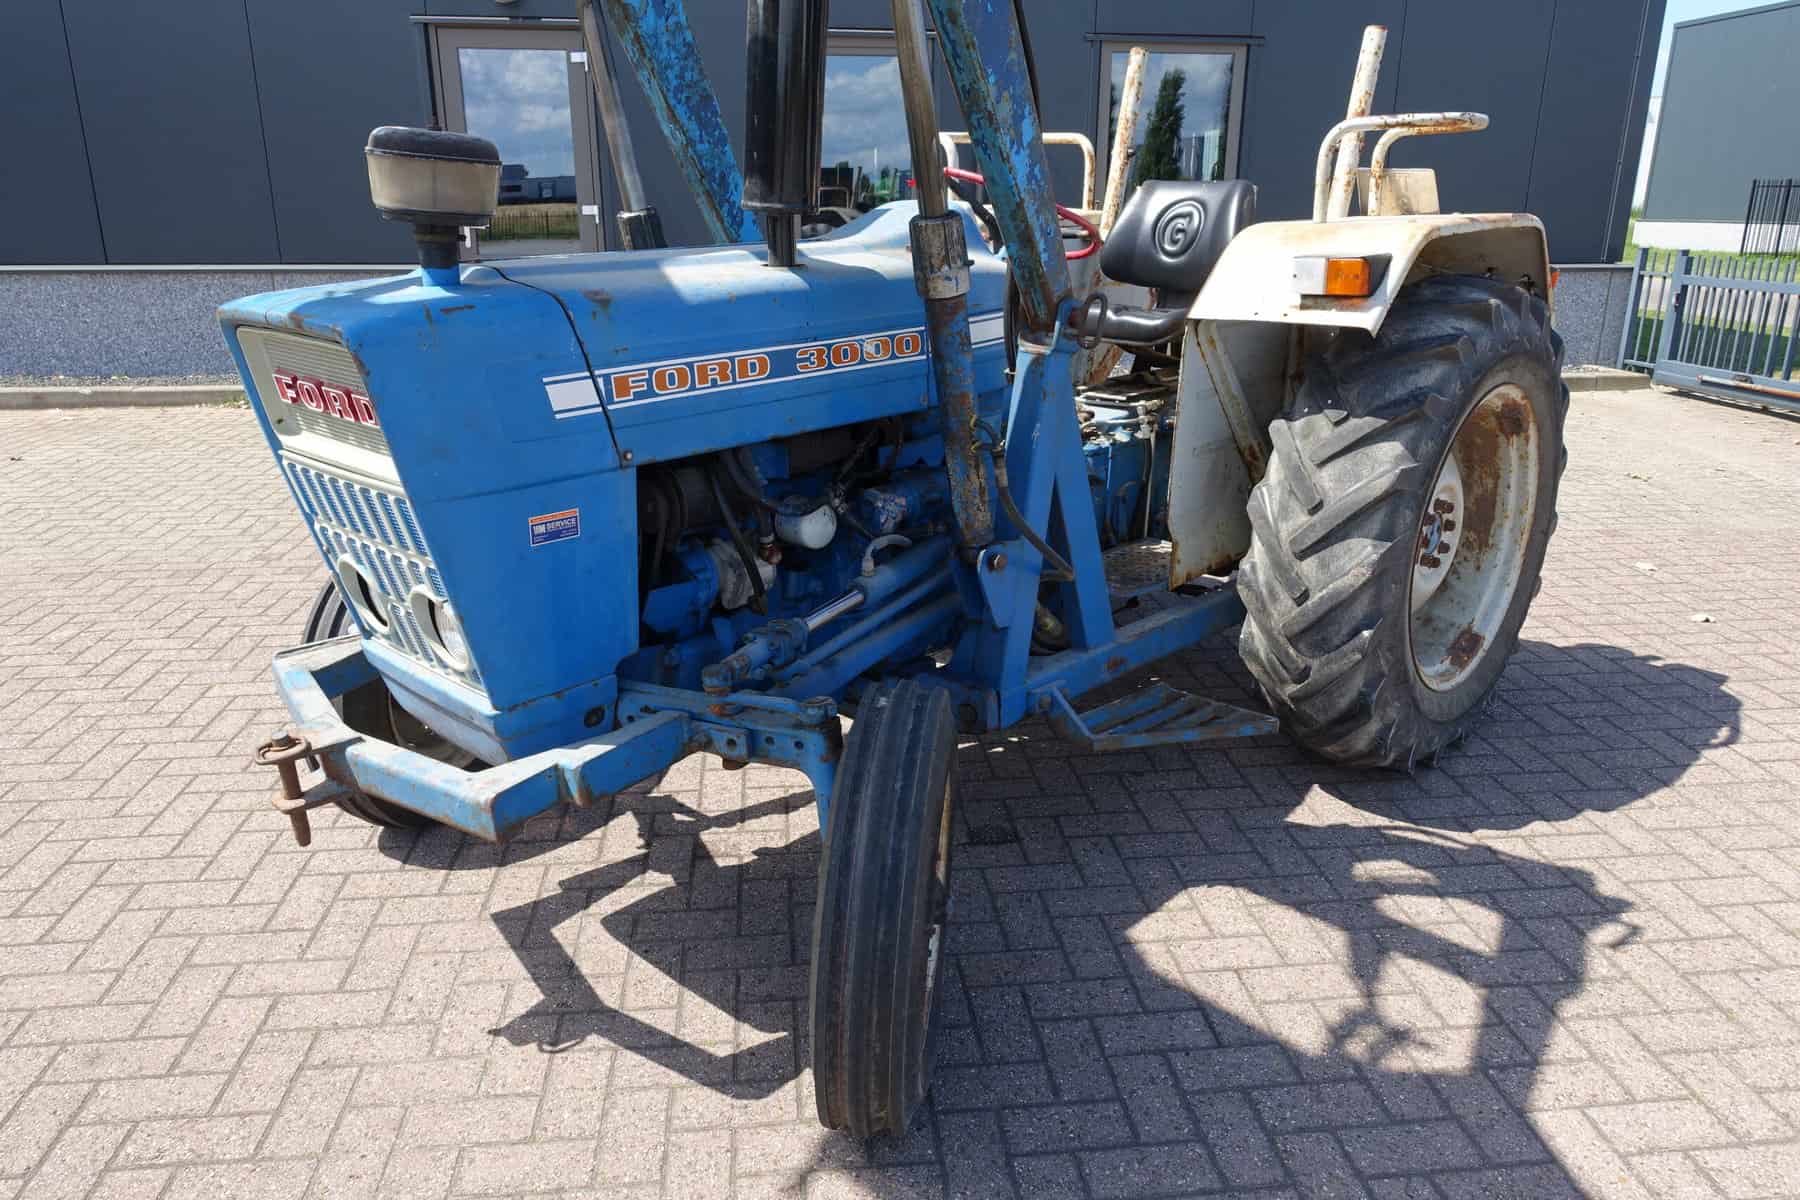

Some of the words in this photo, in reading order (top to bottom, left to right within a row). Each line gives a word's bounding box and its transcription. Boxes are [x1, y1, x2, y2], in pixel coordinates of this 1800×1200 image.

[611, 353, 770, 402] FORD
[796, 332, 922, 373] 3000
[272, 373, 380, 428] FORD
